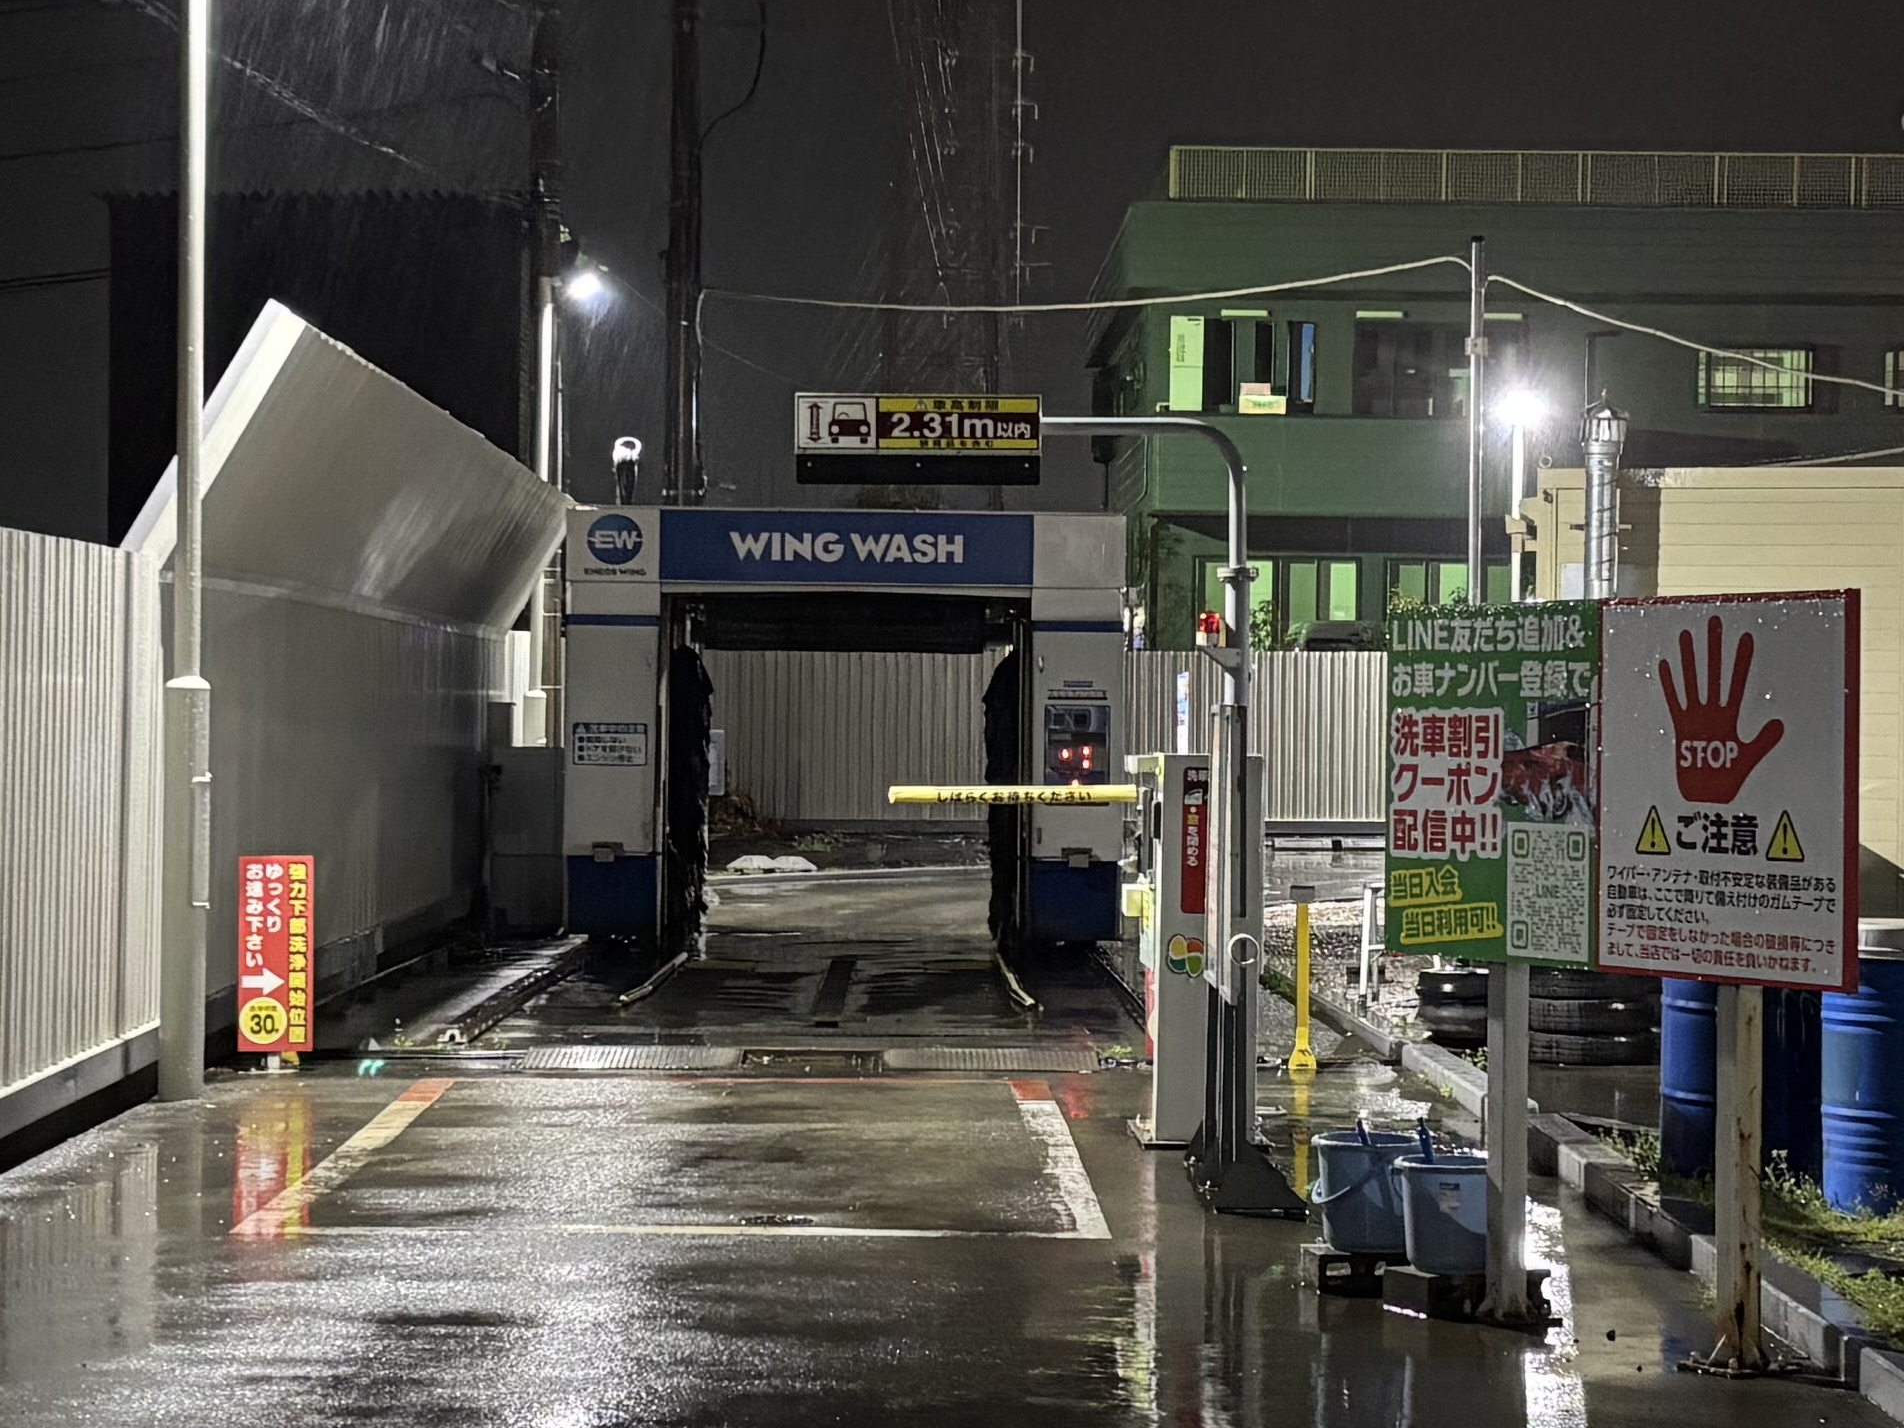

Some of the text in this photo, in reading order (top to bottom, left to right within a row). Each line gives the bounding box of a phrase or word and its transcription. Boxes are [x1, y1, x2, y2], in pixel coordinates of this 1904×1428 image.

[730, 531, 964, 564] WING WASH
[1392, 660, 1591, 698] お車ナンバー登録で
[1394, 713, 1500, 759] 洗車割引
[1679, 739, 1739, 769] STOP
[1394, 762, 1498, 806] クーポン
[1675, 811, 1759, 857] ご注意
[266, 863, 283, 933] ゆっくり
[1391, 866, 1459, 900] 当日入会
[246, 863, 264, 968] お進み下さい
